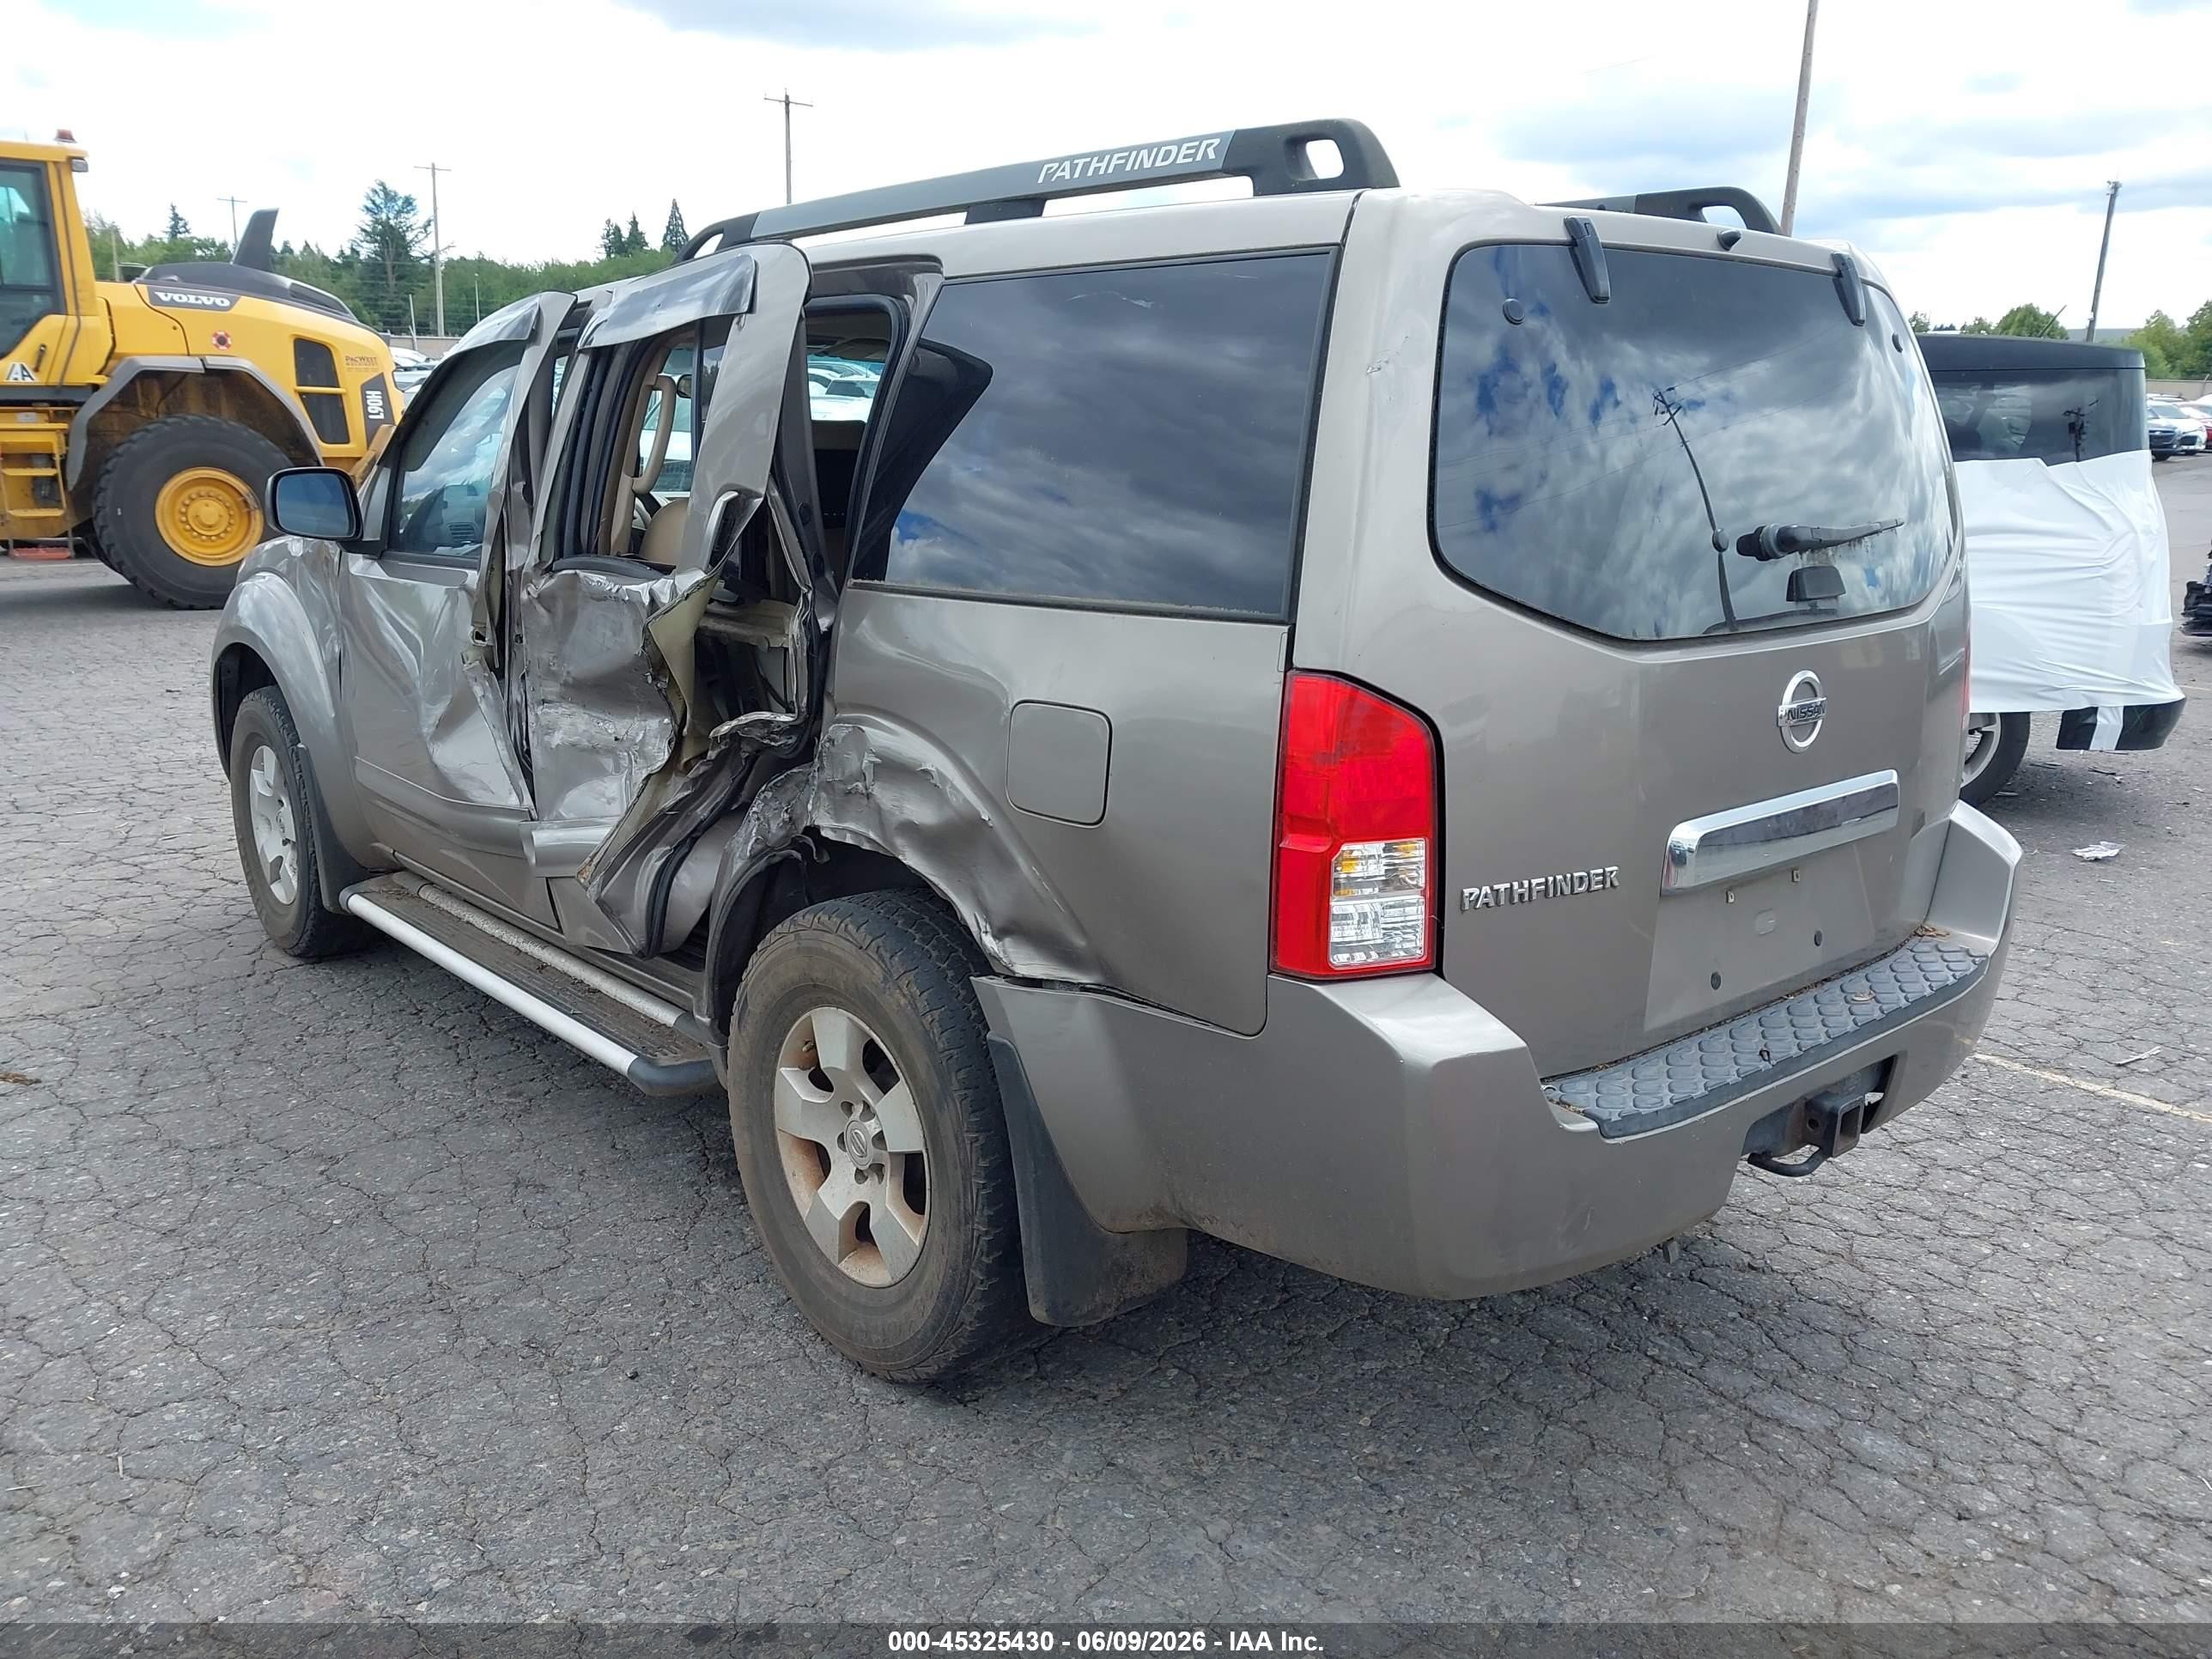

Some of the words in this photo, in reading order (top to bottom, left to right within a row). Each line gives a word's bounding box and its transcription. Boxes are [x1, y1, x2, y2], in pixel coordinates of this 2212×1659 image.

[1037, 137, 1221, 185] PATHFINDER
[154, 291, 231, 307] VOLVO
[365, 390, 386, 420] L90H
[1786, 702, 1826, 722] NISSAN
[1461, 866, 1620, 911] PATHFINDER
